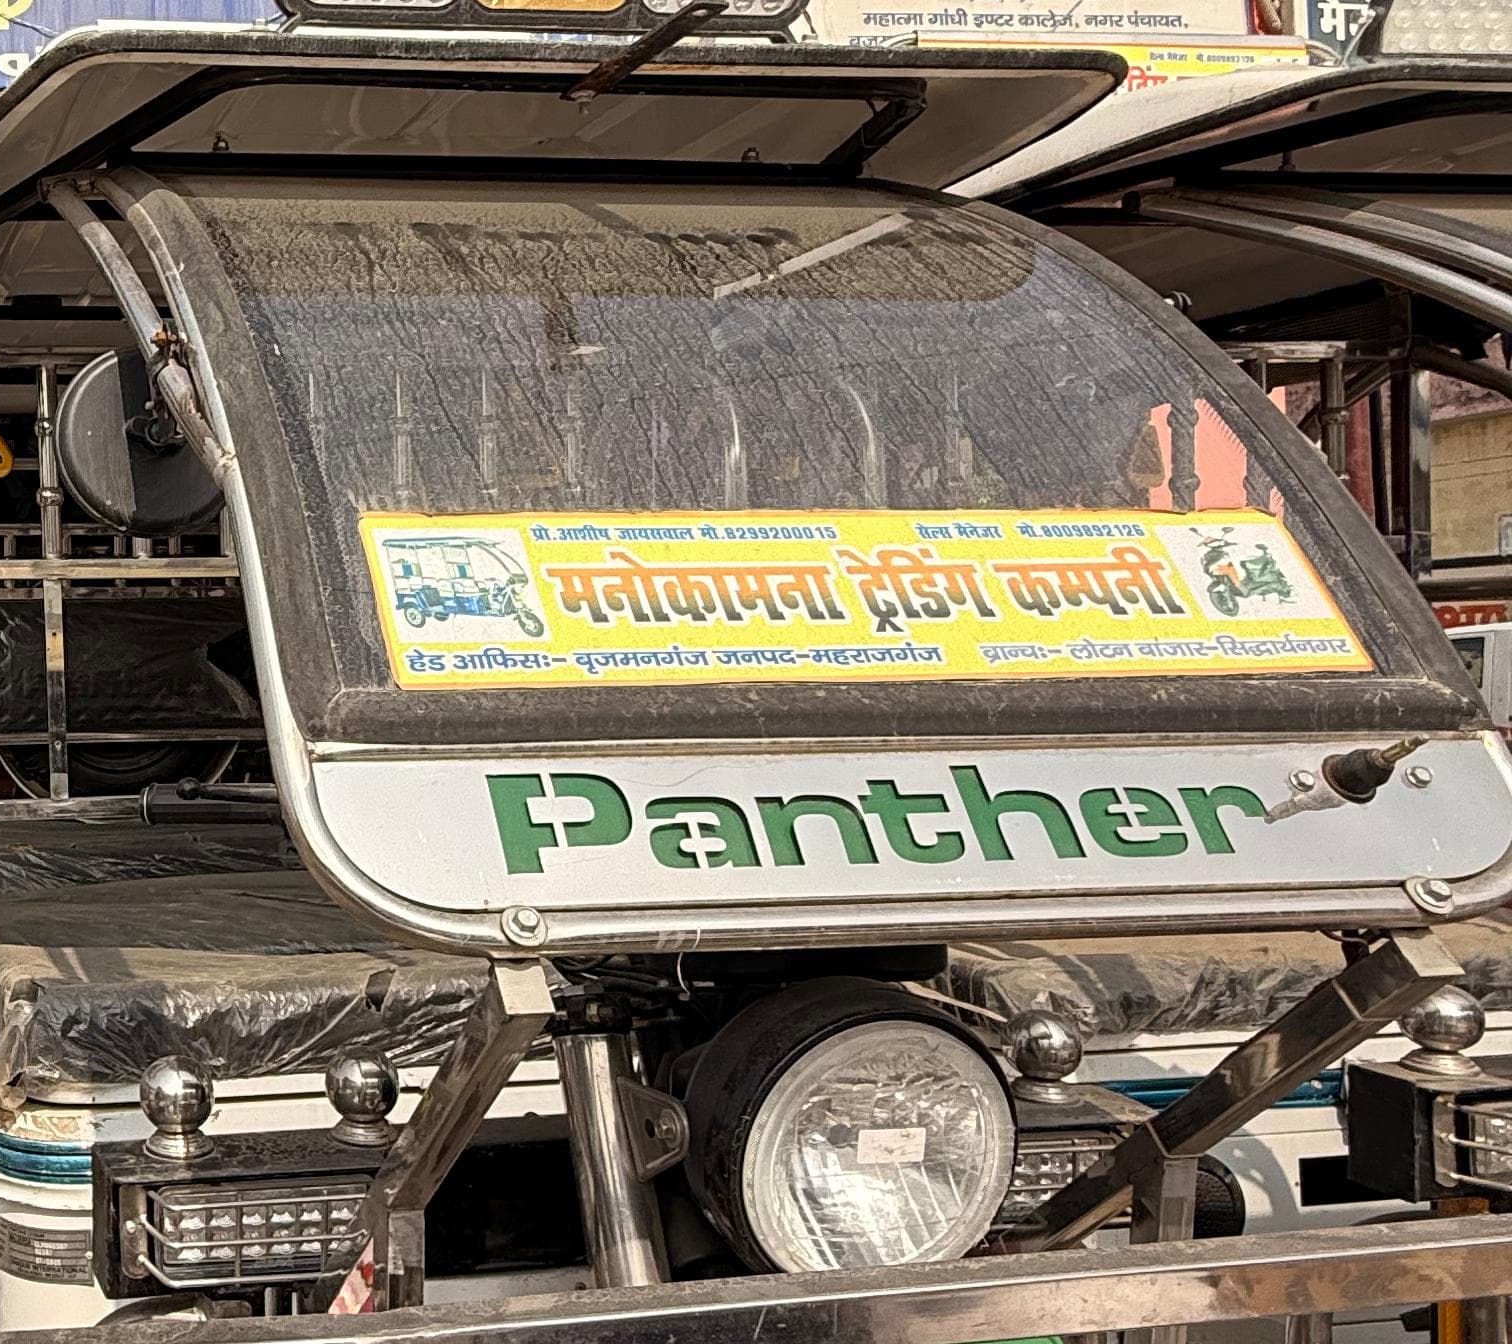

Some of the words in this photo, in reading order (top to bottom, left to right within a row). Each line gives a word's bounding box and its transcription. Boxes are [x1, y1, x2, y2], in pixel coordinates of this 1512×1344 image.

[862, 12, 923, 28] महात्मा
[928, 8, 968, 27] गांधी
[973, 12, 1014, 30] इण्टर
[1084, 13, 1124, 28] नगर
[614, 526, 694, 541] जायसवाल
[546, 551, 845, 624] मनोकामना
[838, 546, 995, 634] ट्रेडिंग
[991, 545, 1187, 618] कम्पनी
[407, 649, 446, 672] हेड
[486, 765, 1276, 878] Panther
